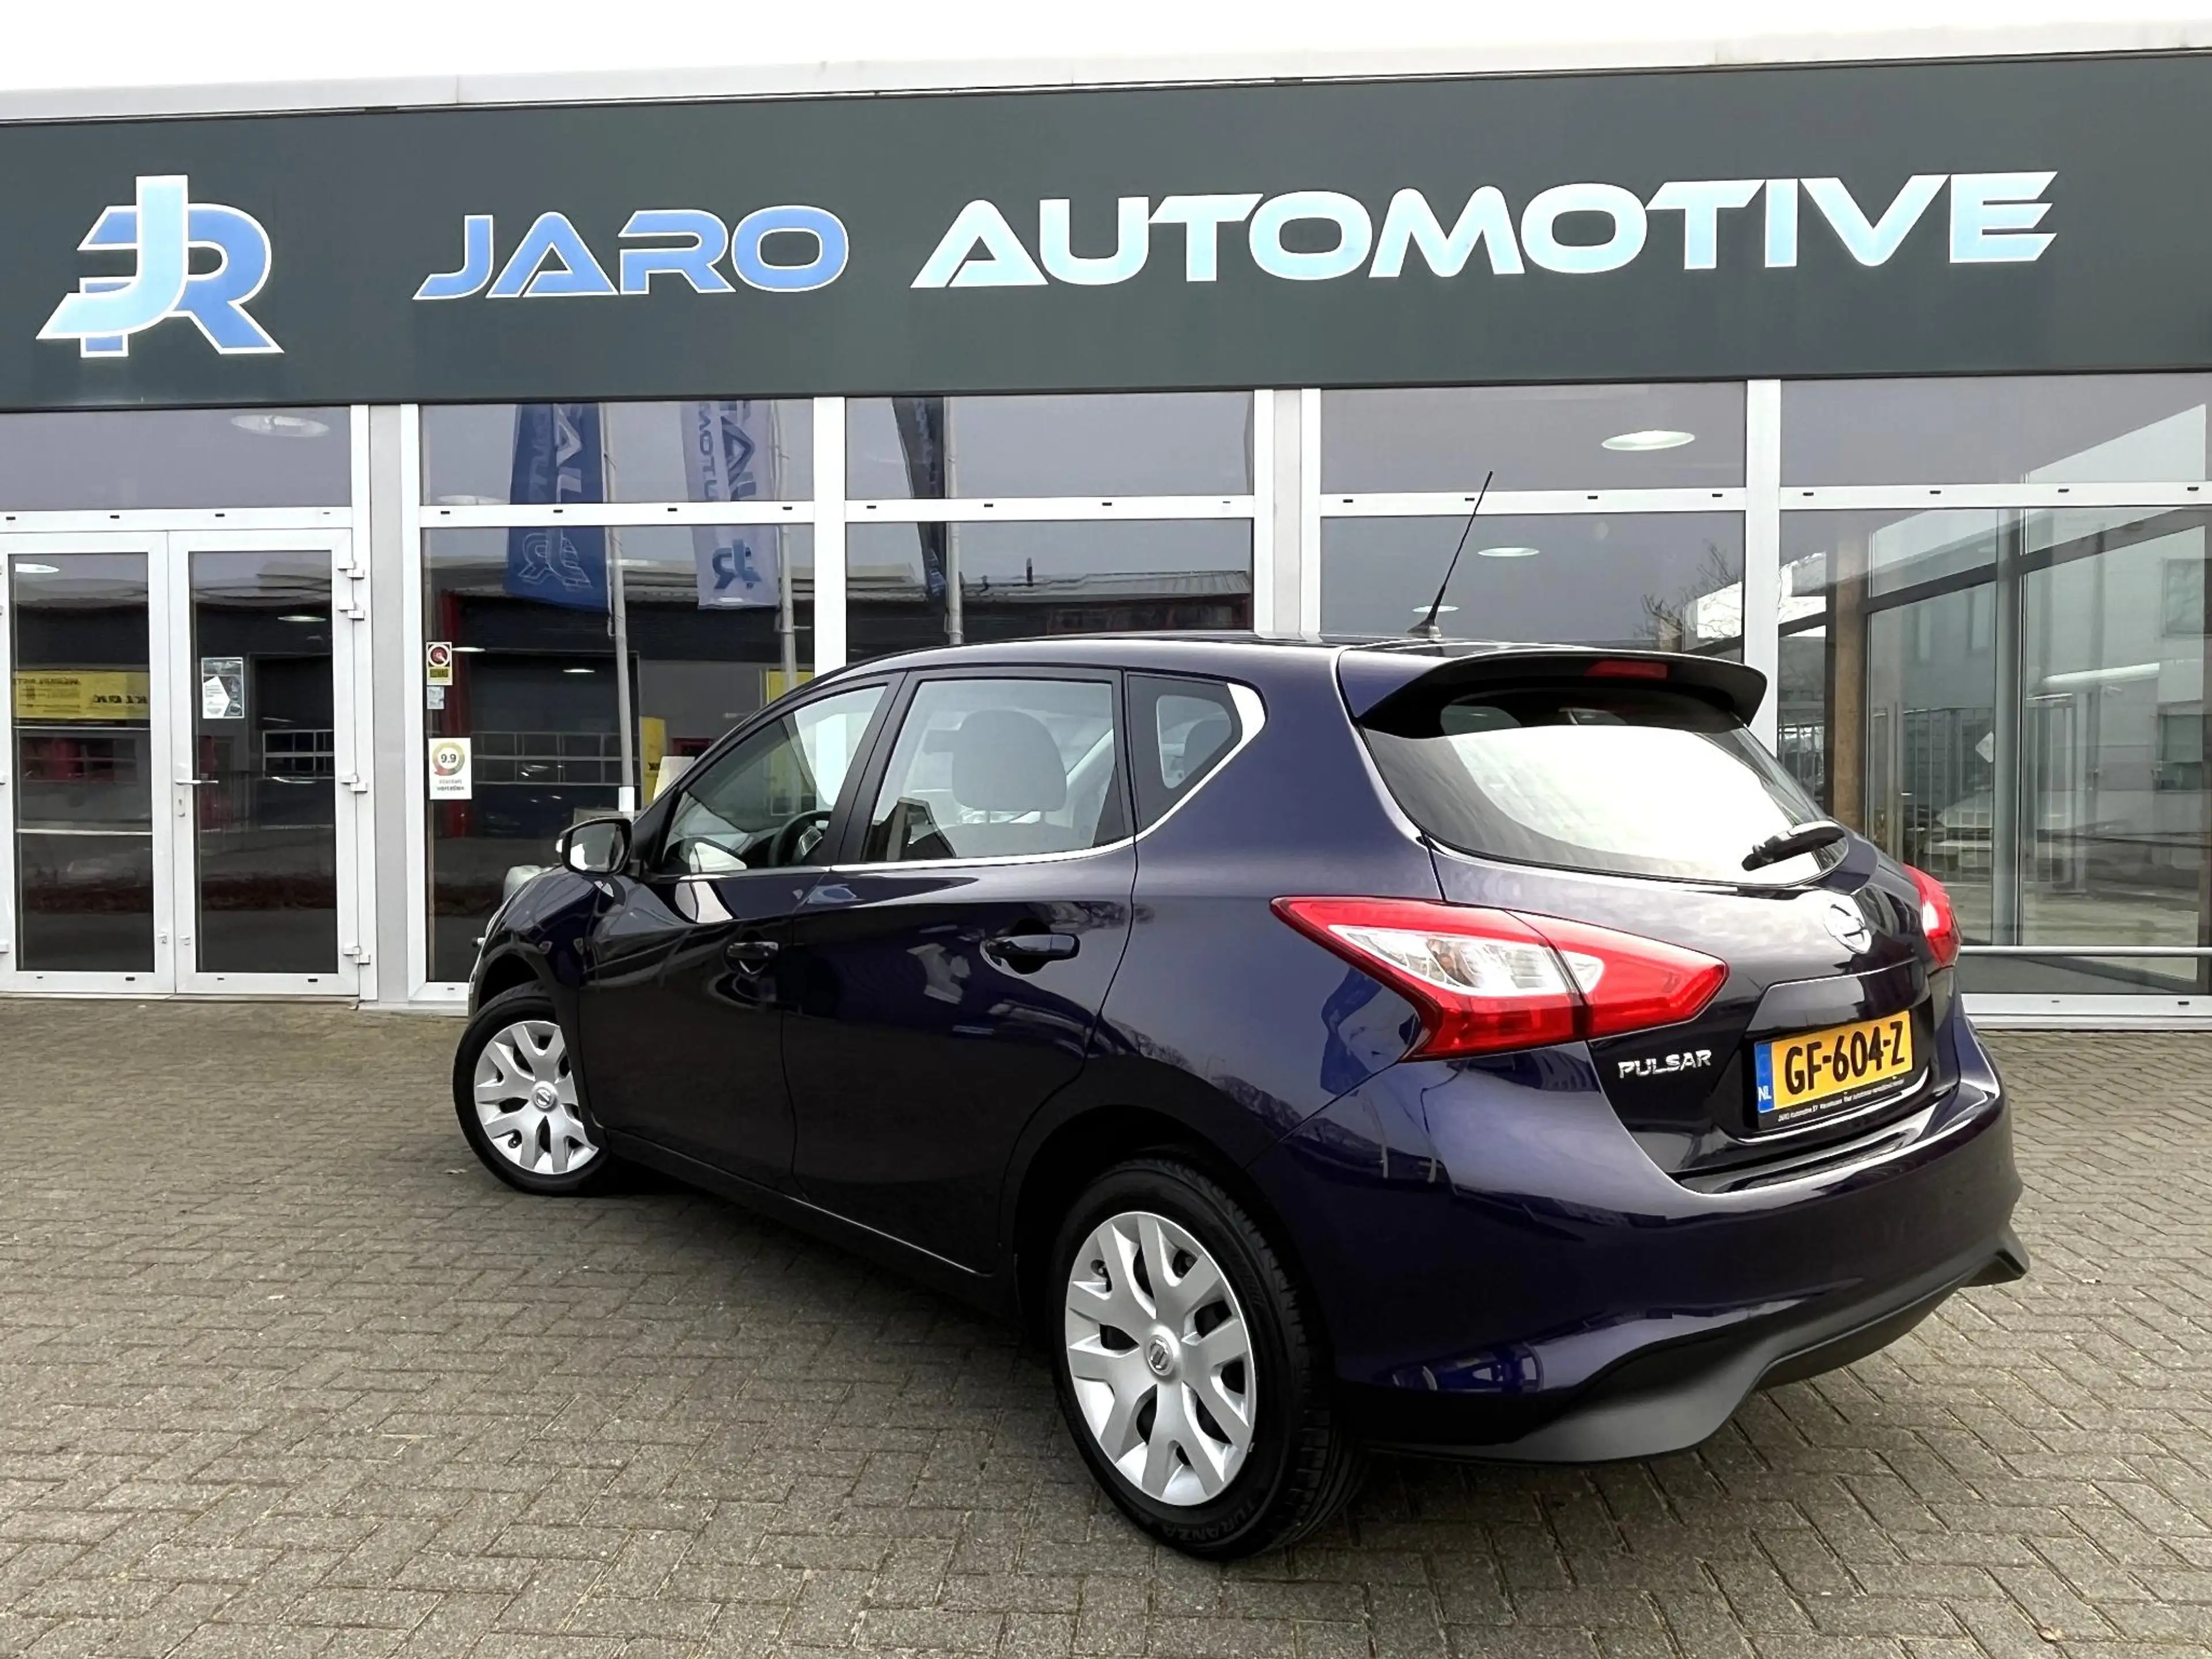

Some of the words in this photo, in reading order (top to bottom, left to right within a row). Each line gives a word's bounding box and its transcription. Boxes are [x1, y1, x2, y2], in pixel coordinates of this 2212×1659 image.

[412, 204, 850, 300] JARO
[910, 171, 2058, 290] AUTOMOTIVE
[441, 753, 457, 763] 9.9
[1618, 1050, 1712, 1079] PULSAR
[1785, 1020, 1905, 1095] GF-604-Z
[1758, 1085, 1772, 1101] NL
